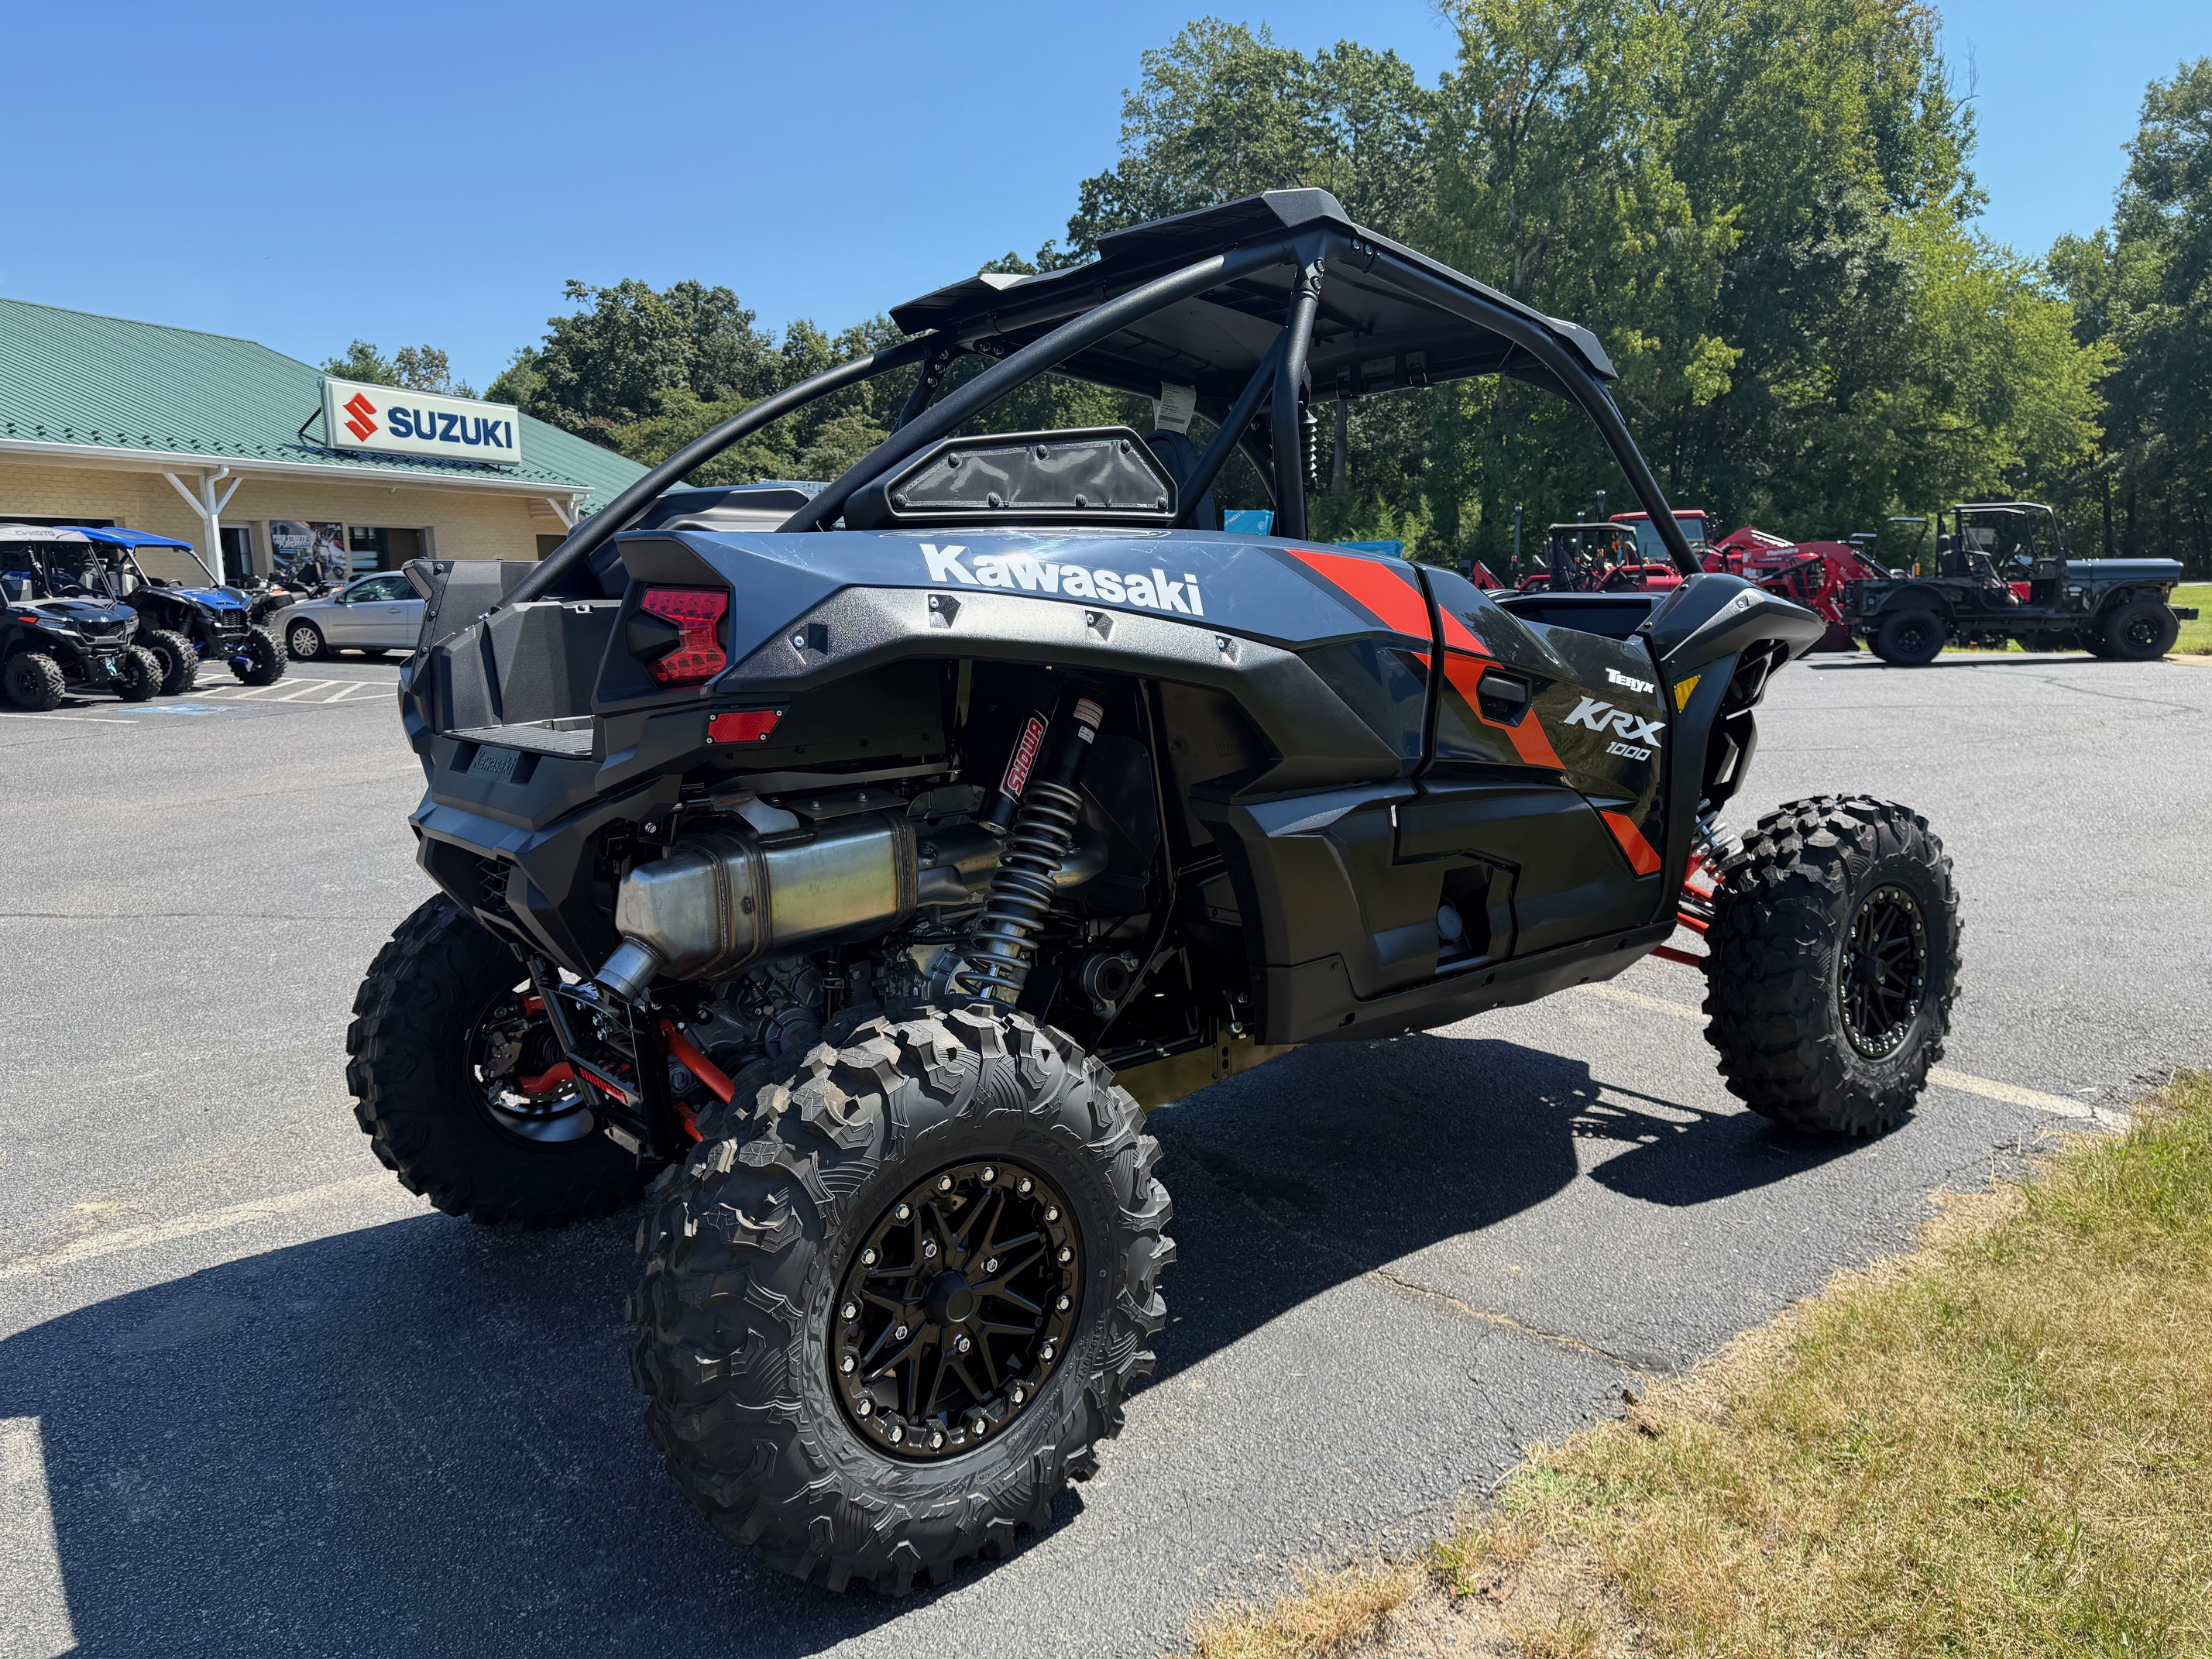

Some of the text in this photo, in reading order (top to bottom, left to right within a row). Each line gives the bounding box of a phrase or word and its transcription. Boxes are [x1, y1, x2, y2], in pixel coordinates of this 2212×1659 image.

[388, 407, 513, 448] SUZUKI
[919, 544, 1204, 617] Kawasaki
[1563, 696, 1666, 747] KRX
[473, 751, 517, 775] Kawasaki
[1007, 717, 1044, 797] SHOWA
[1606, 741, 1651, 761] 1000
